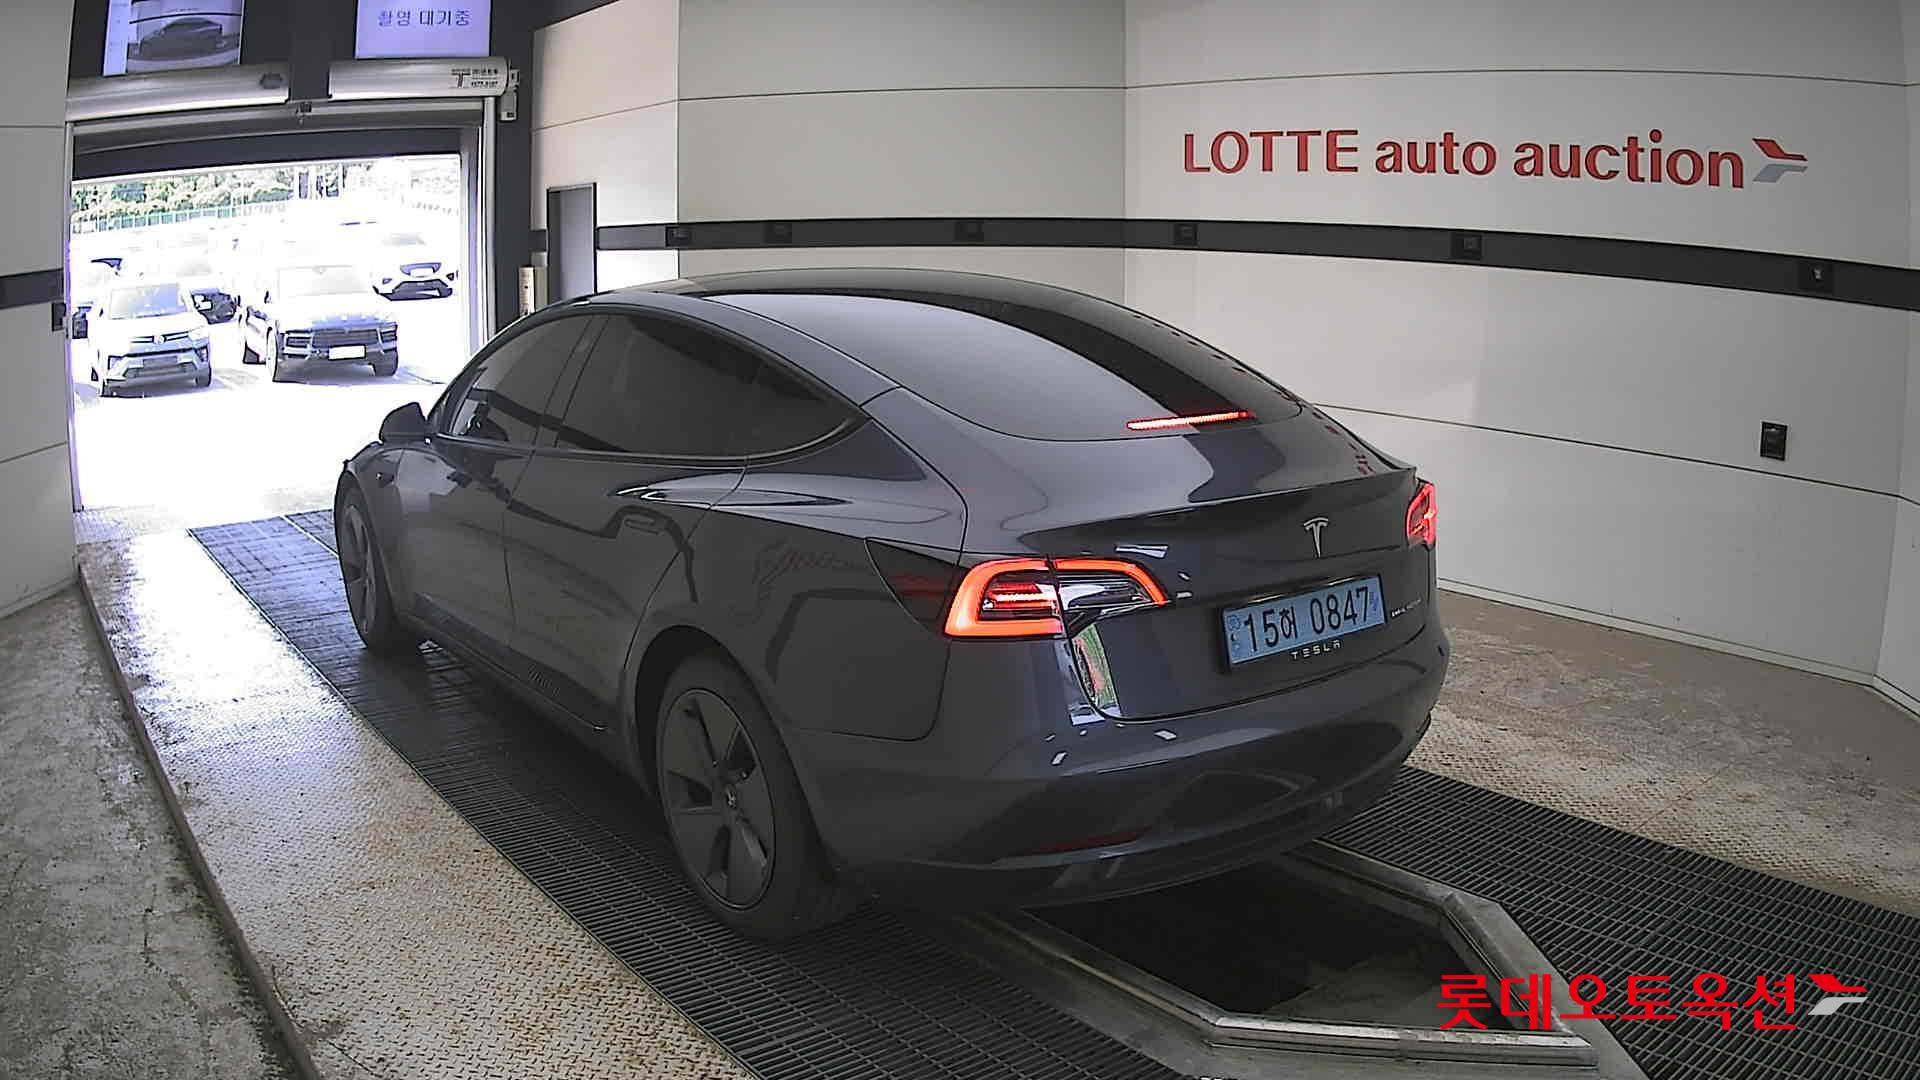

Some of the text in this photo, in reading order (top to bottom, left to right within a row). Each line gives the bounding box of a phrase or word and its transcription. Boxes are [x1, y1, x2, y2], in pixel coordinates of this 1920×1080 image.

[419, 10, 471, 27] 대기중
[1184, 128, 1745, 189] LOTTE auto auction
[1243, 606, 1299, 652] 15허
[1310, 585, 1370, 635] 0847
[1291, 639, 1341, 660] TESLA
